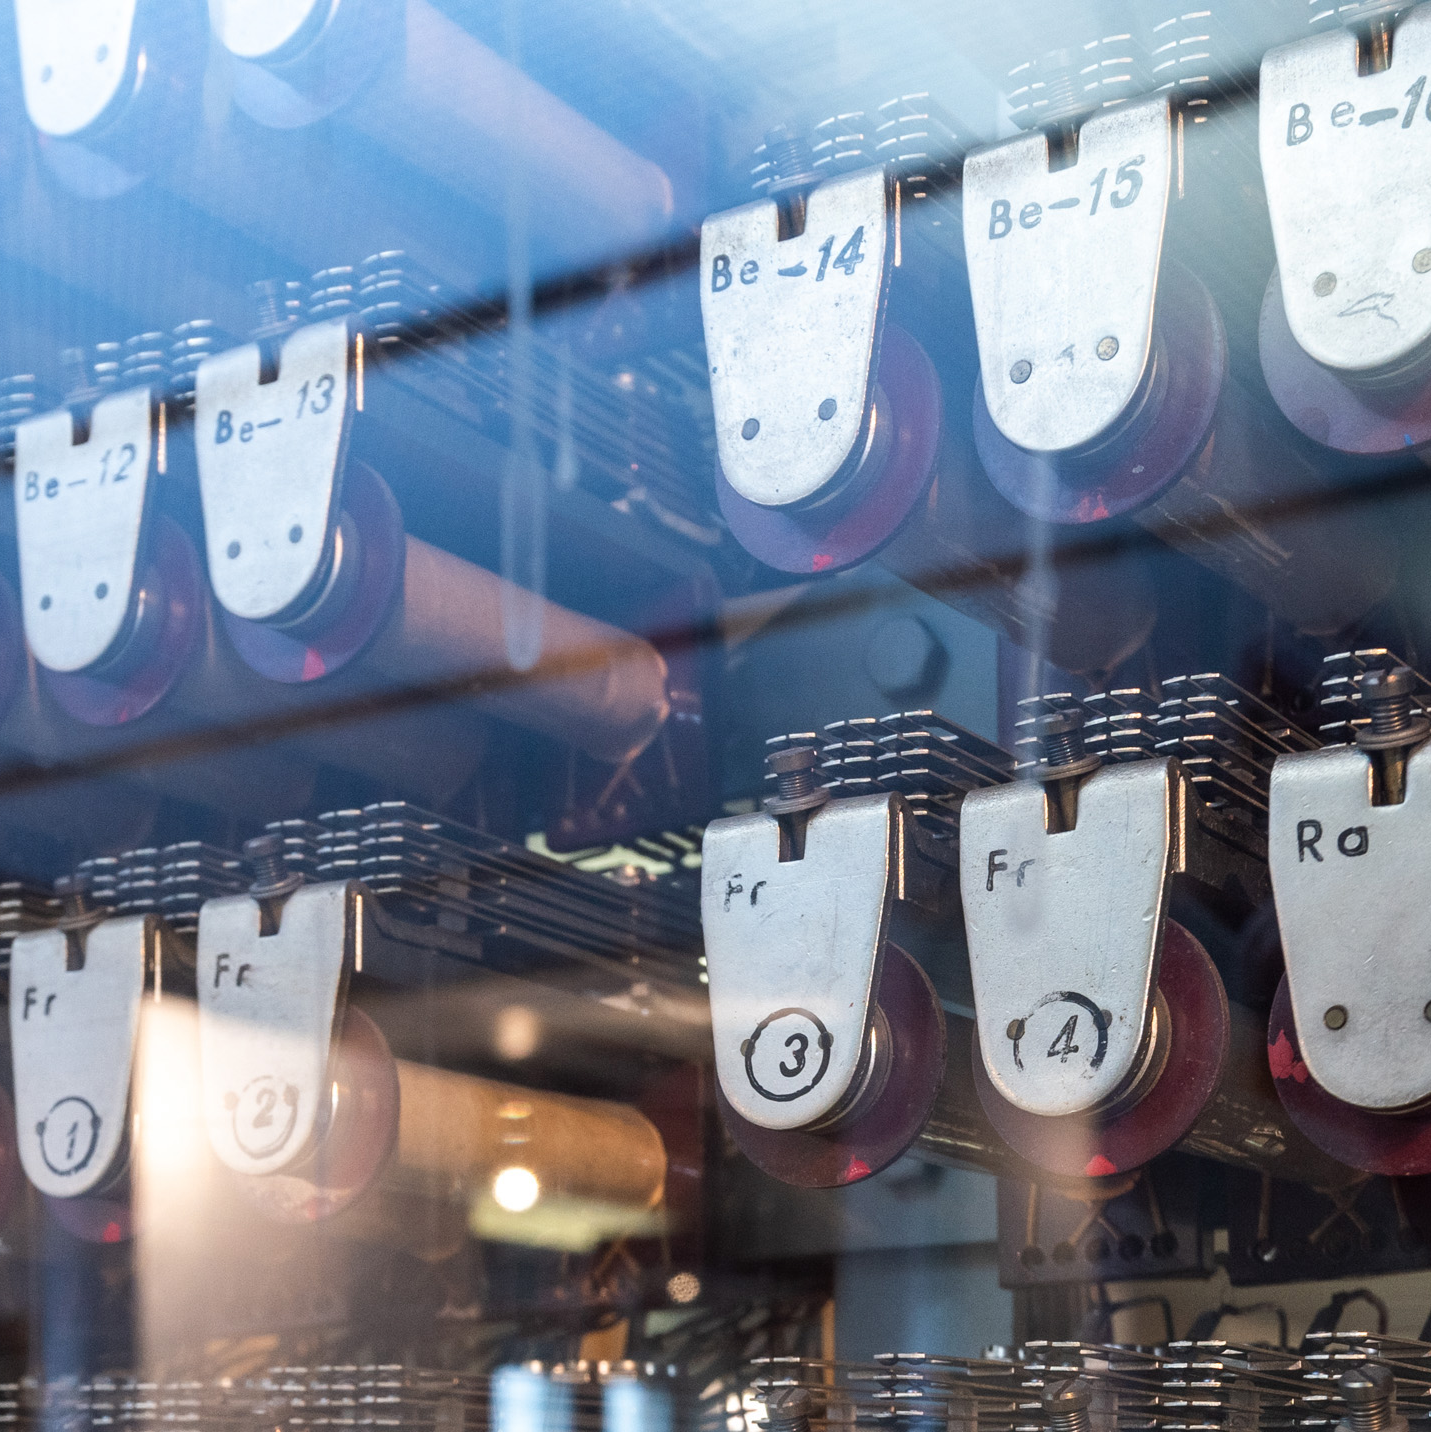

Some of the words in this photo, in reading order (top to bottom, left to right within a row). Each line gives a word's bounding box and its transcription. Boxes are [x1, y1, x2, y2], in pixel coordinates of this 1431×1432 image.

[988, 154, 1147, 241] Be-15
[710, 225, 866, 293] Be-14
[214, 373, 336, 445] Be-13
[24, 442, 137, 502] Be-12
[1295, 819, 1370, 862] Ra
[723, 873, 768, 912] Fr
[986, 848, 1035, 892] Fr
[213, 952, 252, 989] Fr
[22, 986, 57, 1021] Fr
[779, 1032, 809, 1079] 3
[1047, 1014, 1080, 1065] 4
[252, 1087, 275, 1129] 2
